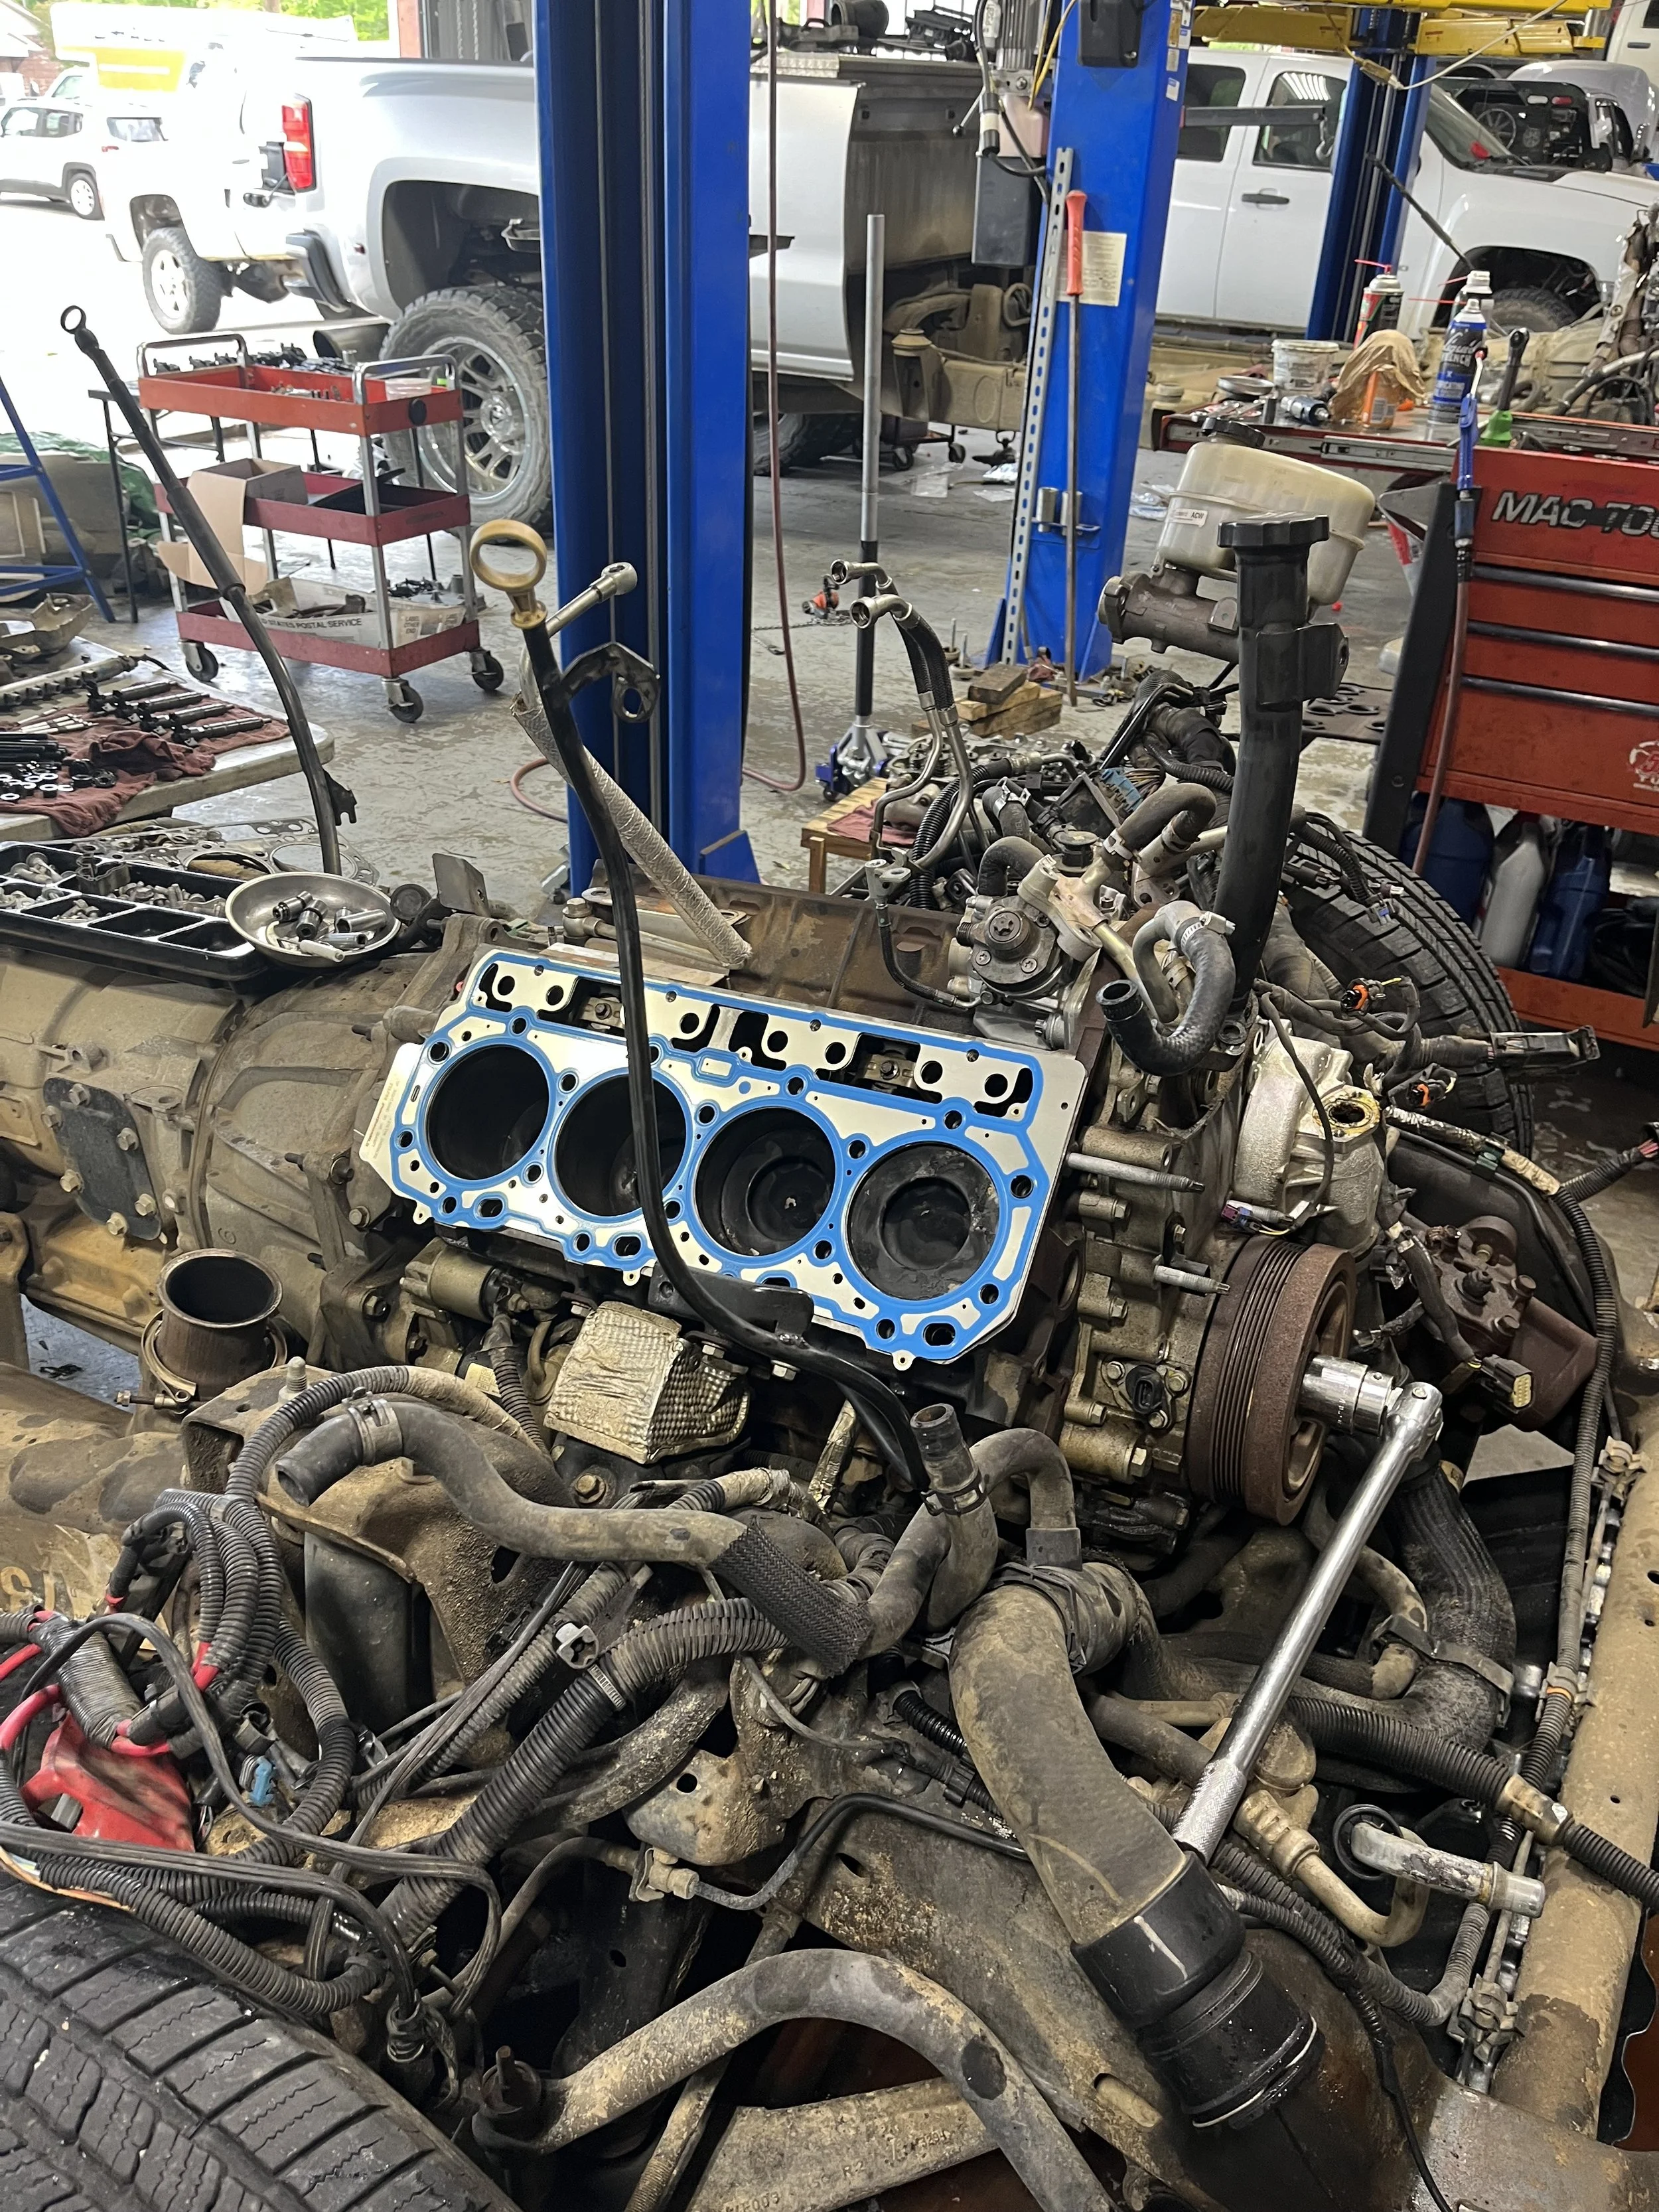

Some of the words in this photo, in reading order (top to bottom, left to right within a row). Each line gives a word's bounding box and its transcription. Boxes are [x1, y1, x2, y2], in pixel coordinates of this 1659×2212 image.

[1491, 490, 1594, 528] MAC
[296, 621, 326, 629] POSTAL
[328, 618, 362, 628] SERVICE
